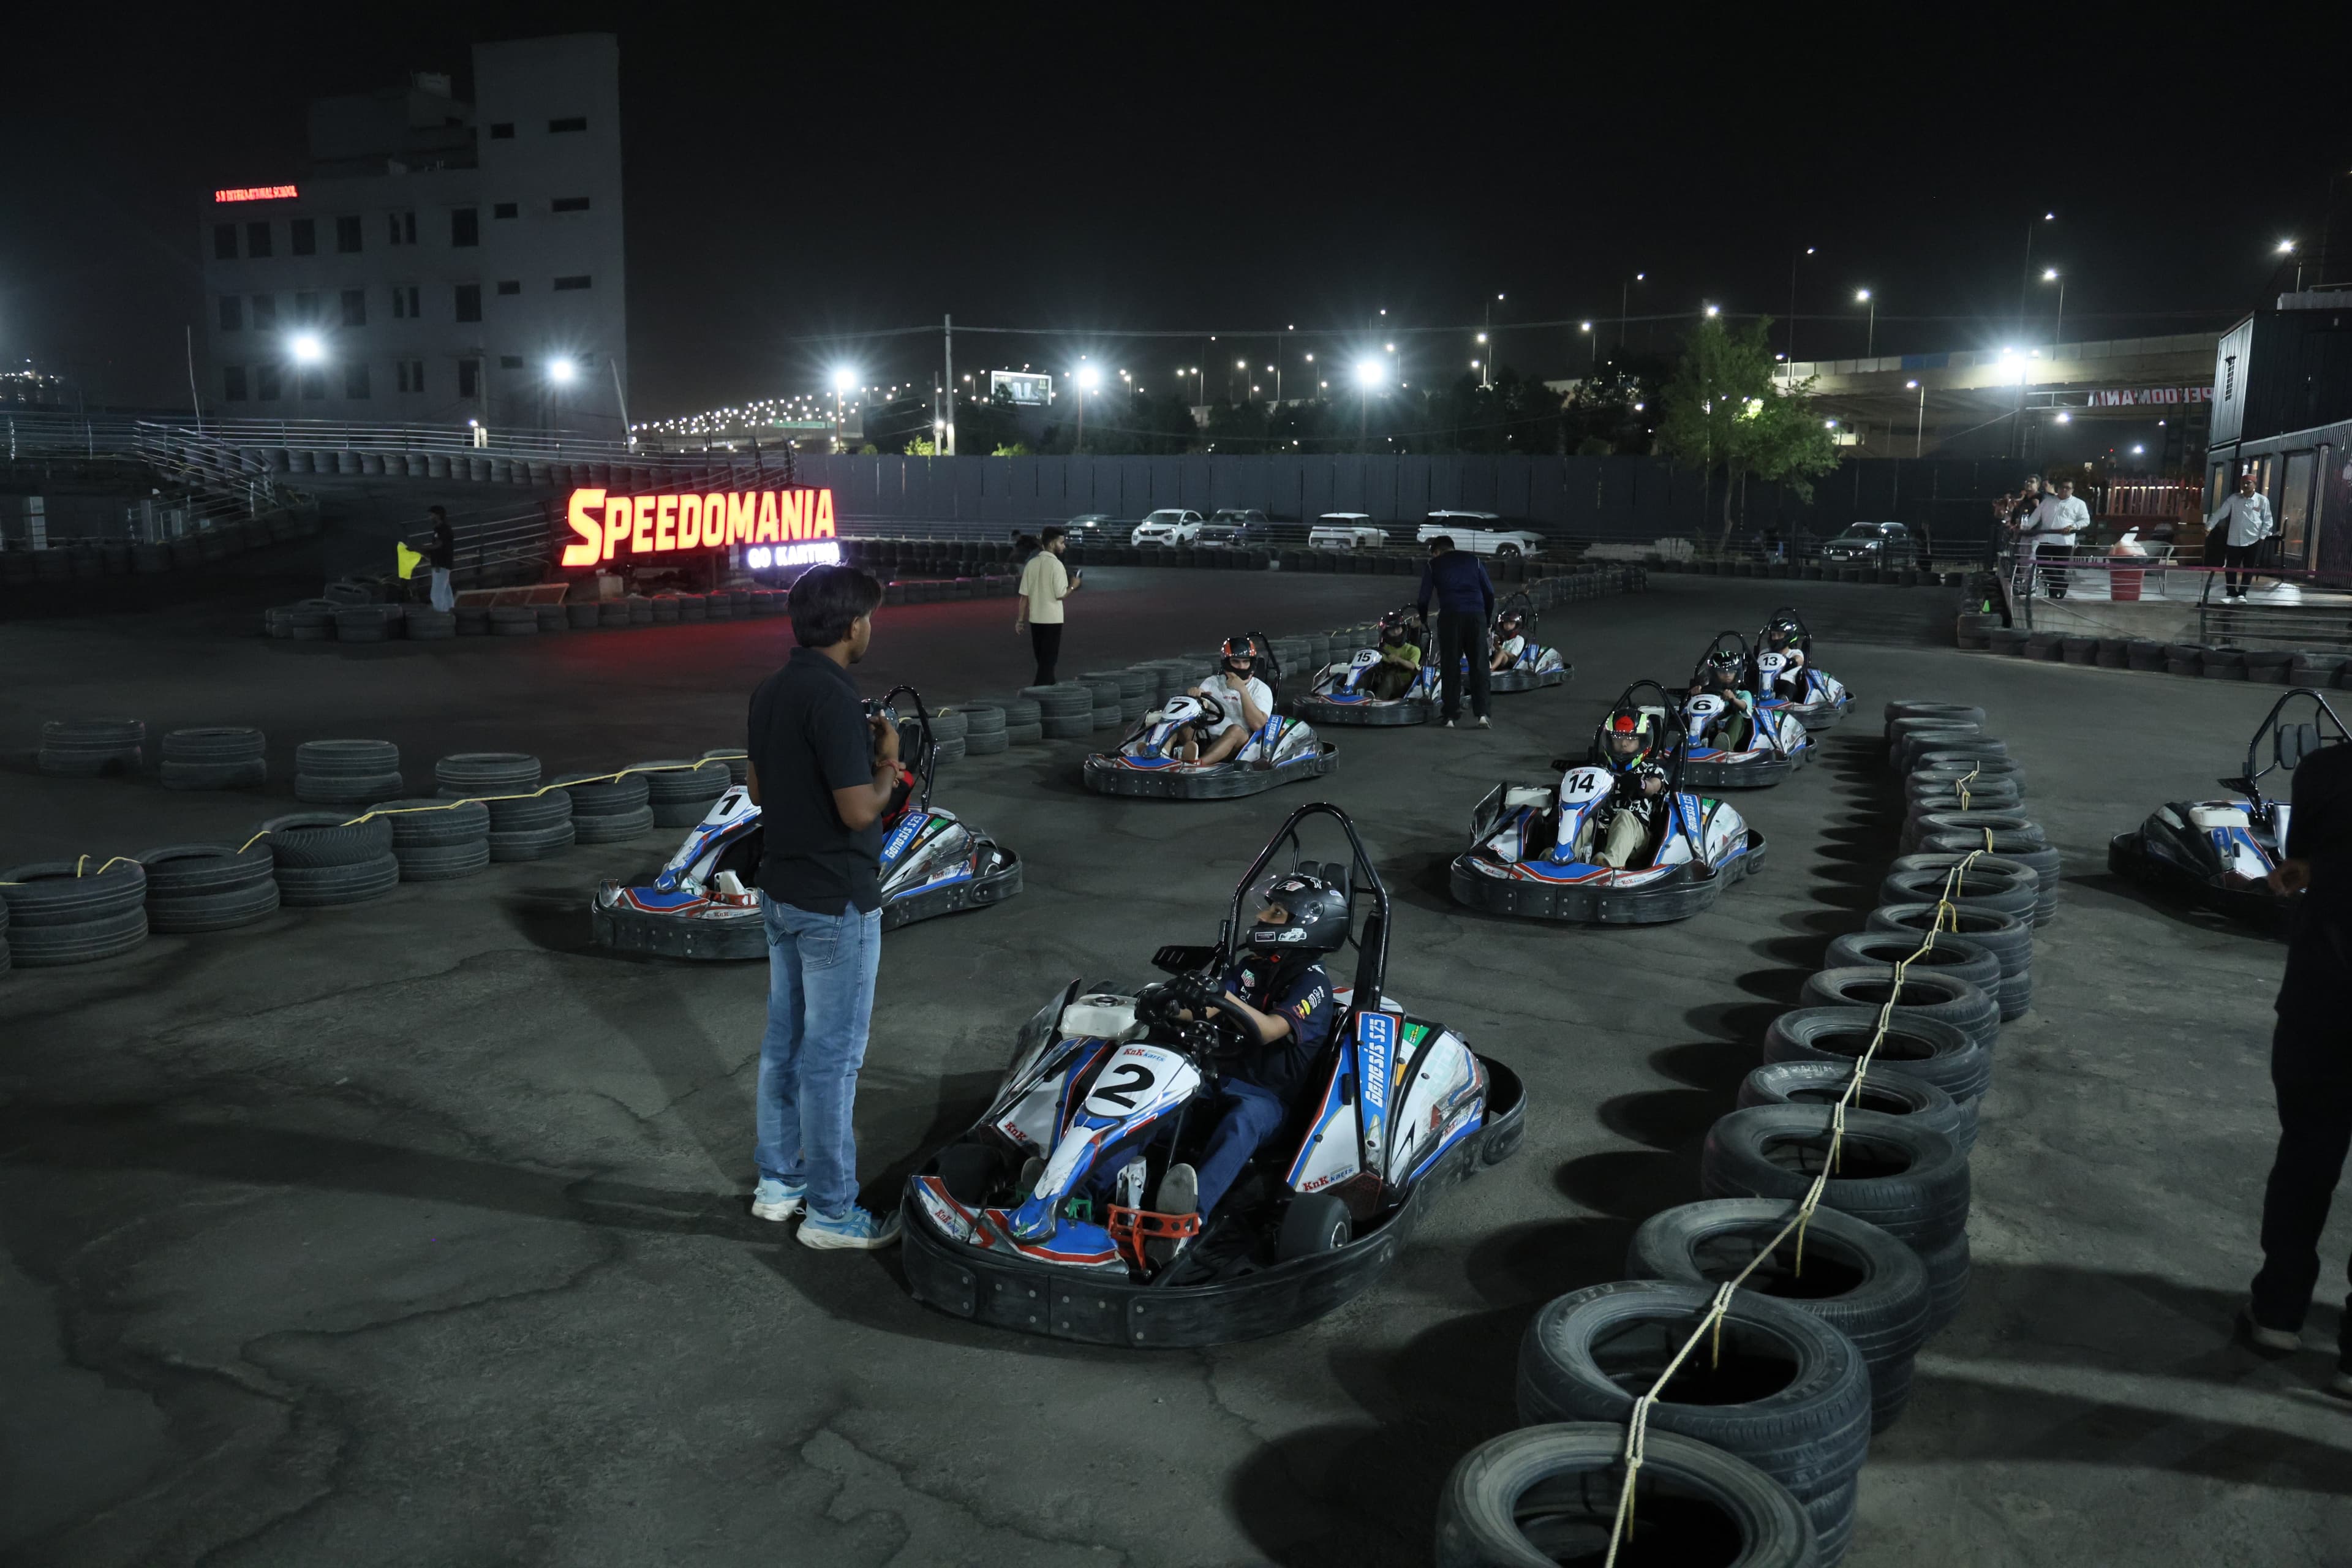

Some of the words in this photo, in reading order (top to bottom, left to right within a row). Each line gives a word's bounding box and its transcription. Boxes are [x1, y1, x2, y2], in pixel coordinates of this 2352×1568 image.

[273, 186, 298, 198] SCHOOL
[562, 488, 836, 567] SPEEDOMANIA
[748, 548, 772, 568] GO
[775, 541, 840, 566] KARTING
[1357, 652, 1372, 662] 15
[1763, 656, 1777, 666] 13
[1168, 701, 1190, 714] 7
[1692, 699, 1712, 710] 6
[1569, 774, 1595, 794] 14
[719, 794, 743, 816] 1
[1091, 1063, 1155, 1110] 2
